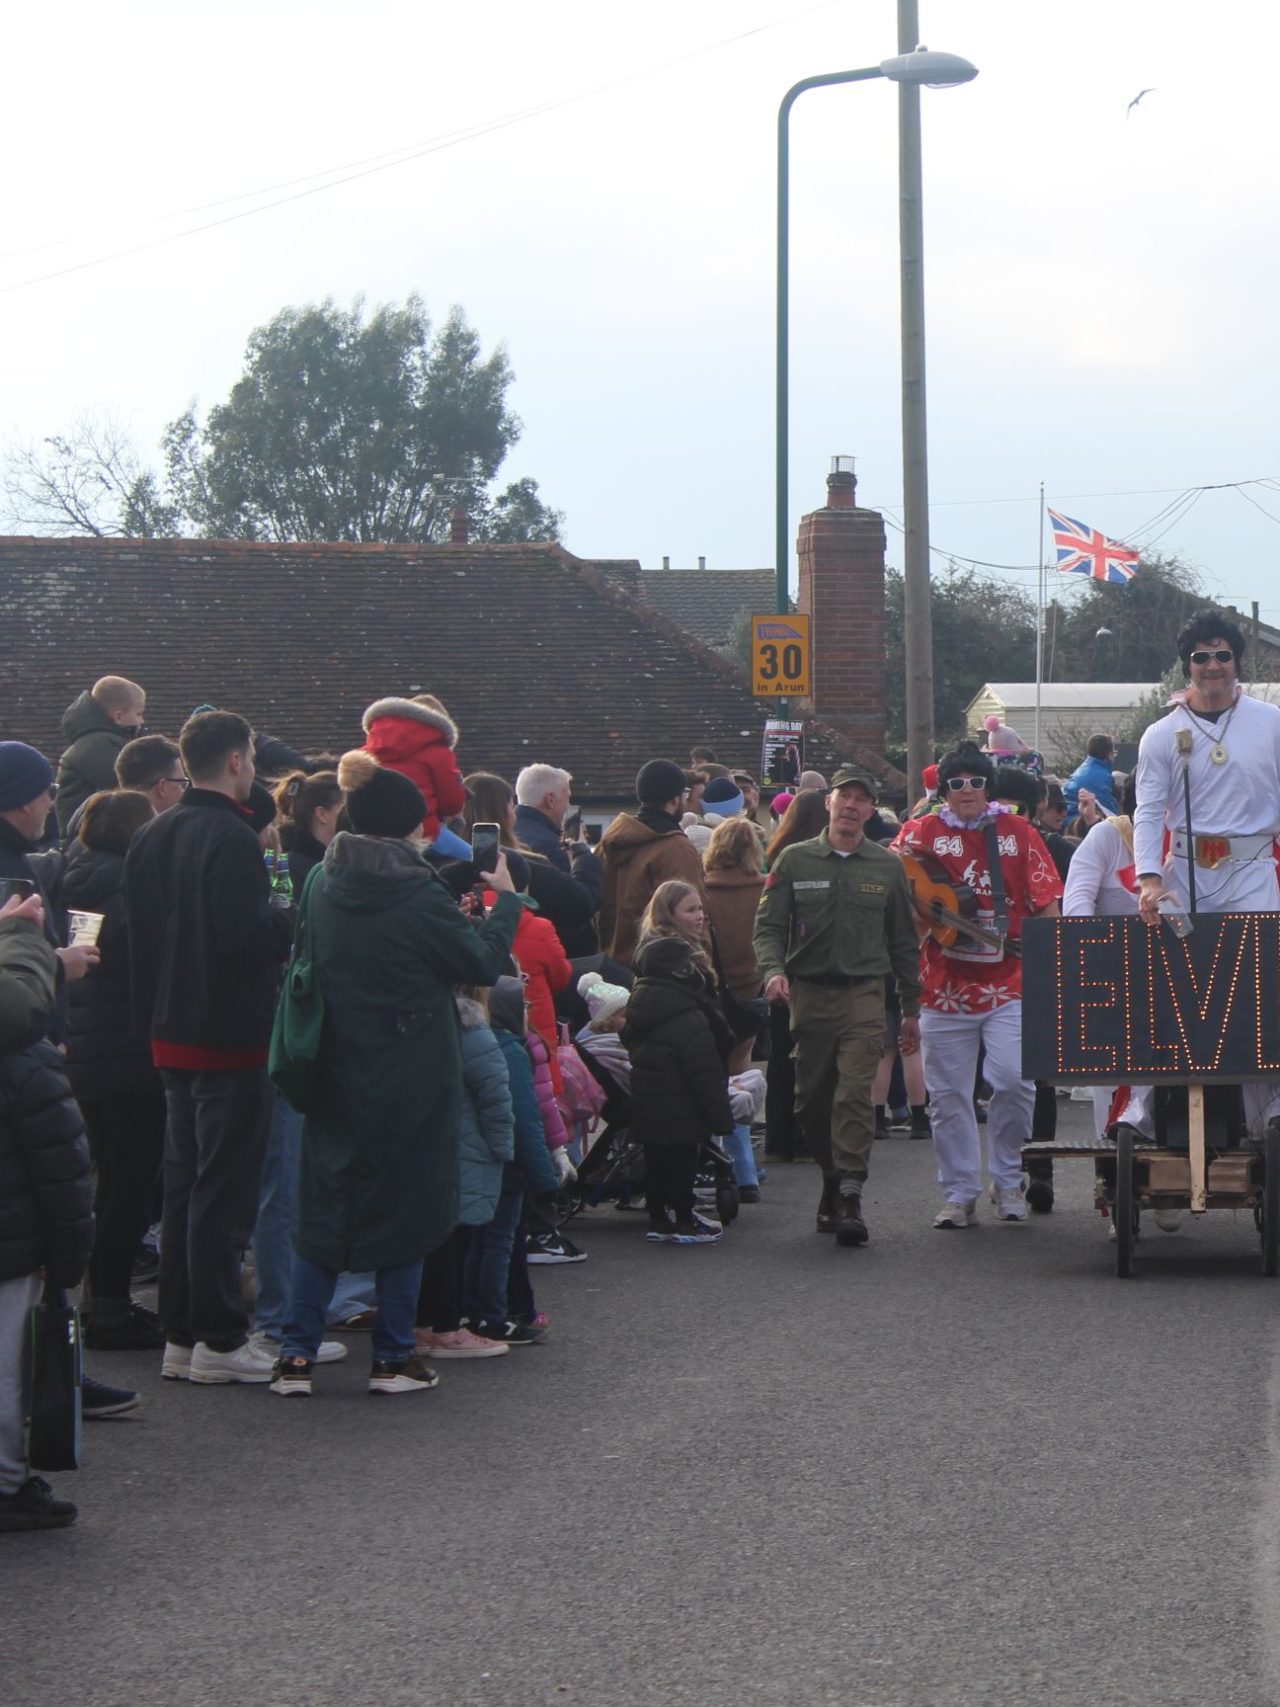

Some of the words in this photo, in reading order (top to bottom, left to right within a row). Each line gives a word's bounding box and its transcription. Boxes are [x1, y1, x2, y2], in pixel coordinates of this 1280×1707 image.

[760, 644, 802, 680] 30
[757, 682, 768, 692] in
[775, 682, 805, 692] Arun
[933, 836, 964, 857] 54
